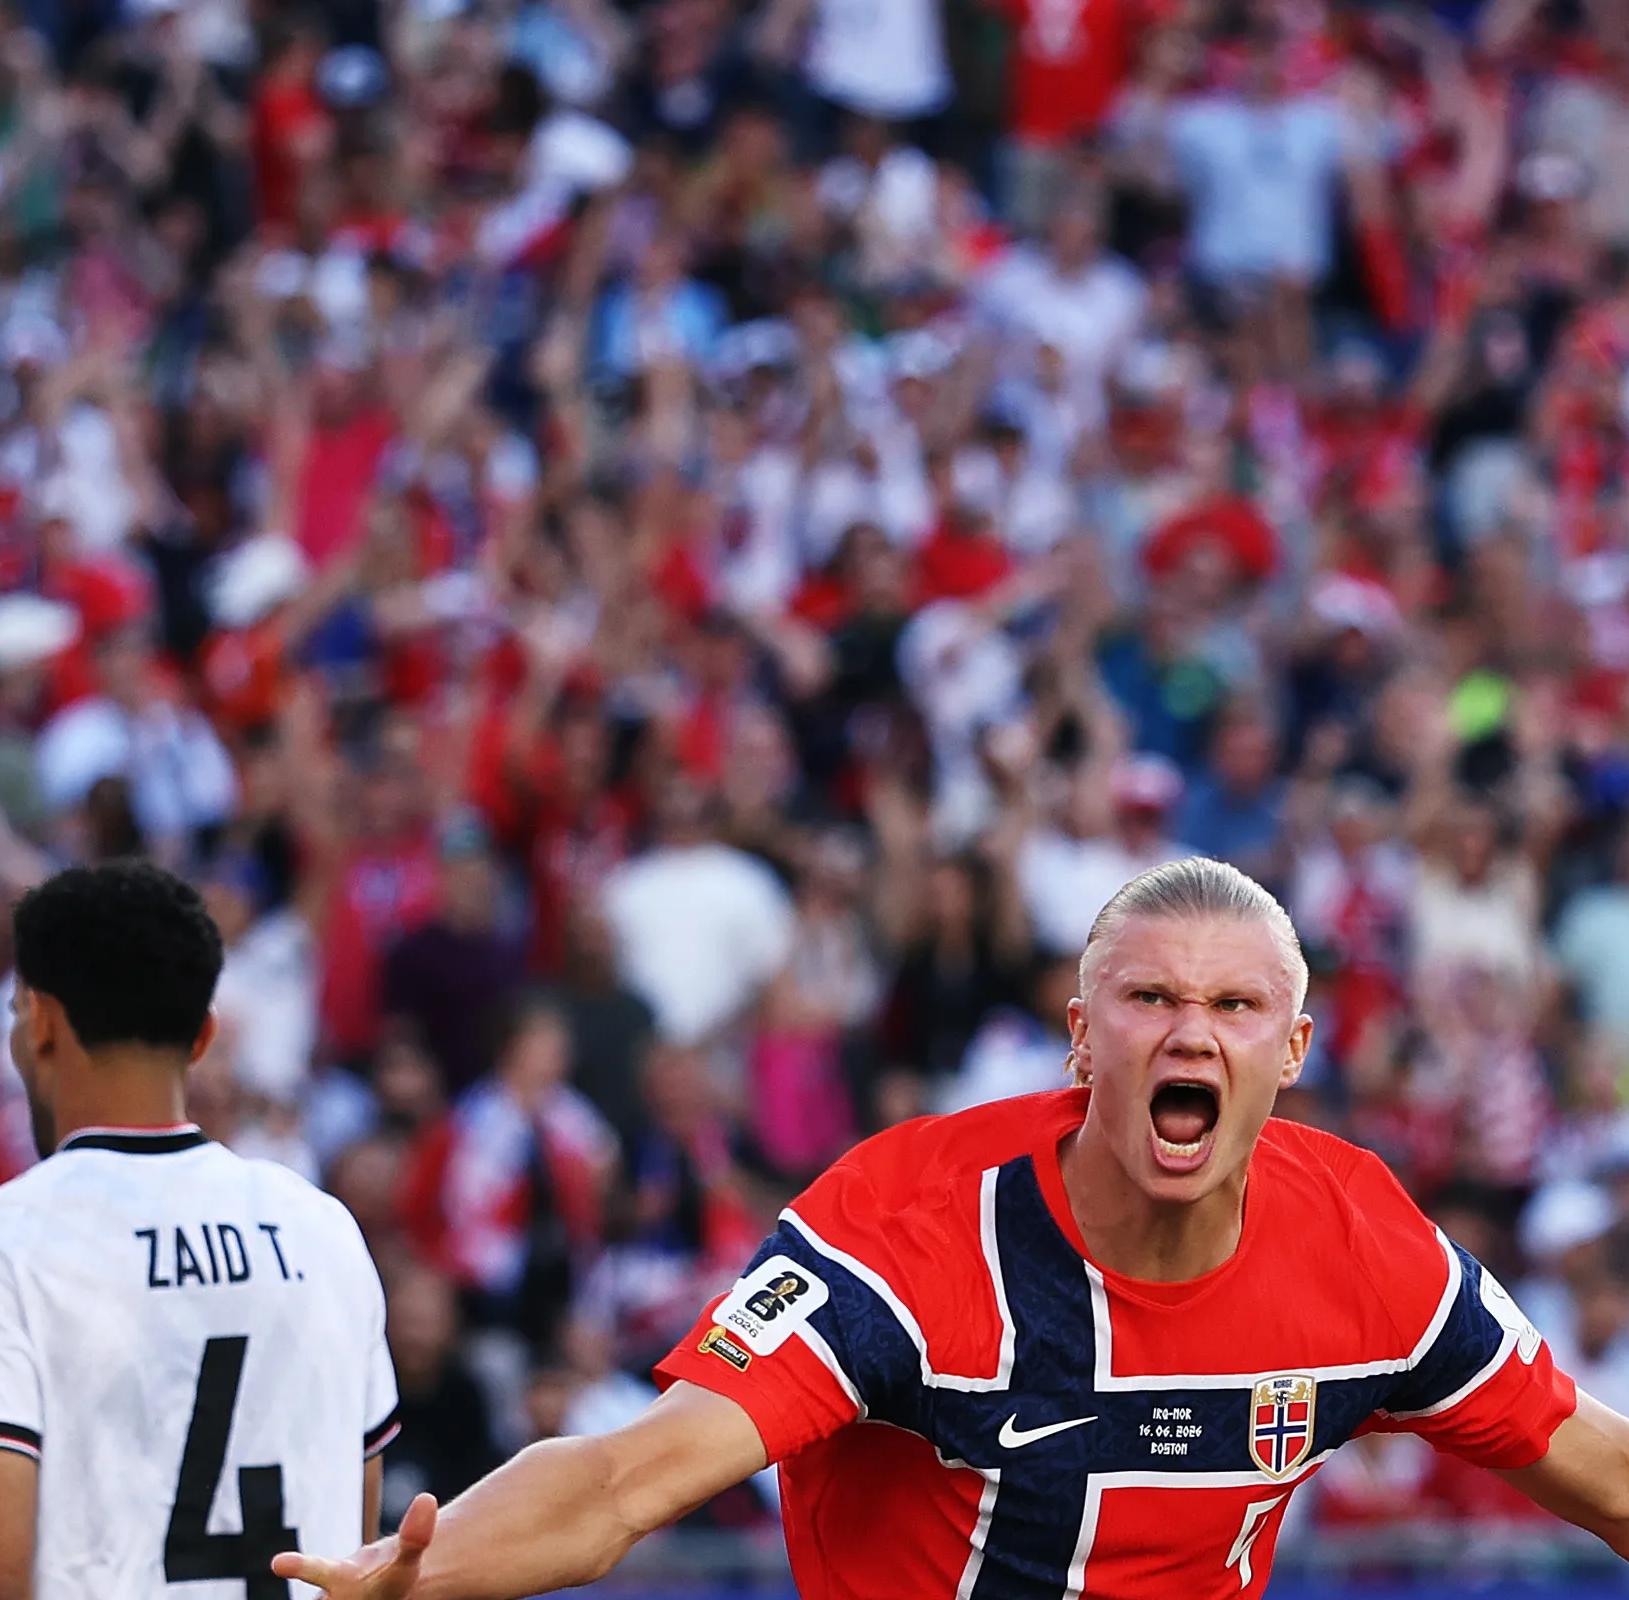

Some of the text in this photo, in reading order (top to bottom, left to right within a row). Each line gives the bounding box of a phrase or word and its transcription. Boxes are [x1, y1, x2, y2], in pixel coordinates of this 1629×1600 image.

[136, 1223, 306, 1288] ZAID T.
[728, 1313, 759, 1338] 2026
[716, 1339, 748, 1362] DEBUT
[1152, 1407, 1193, 1420] IRQ-NOR
[1150, 1442, 1188, 1455] BOSTON
